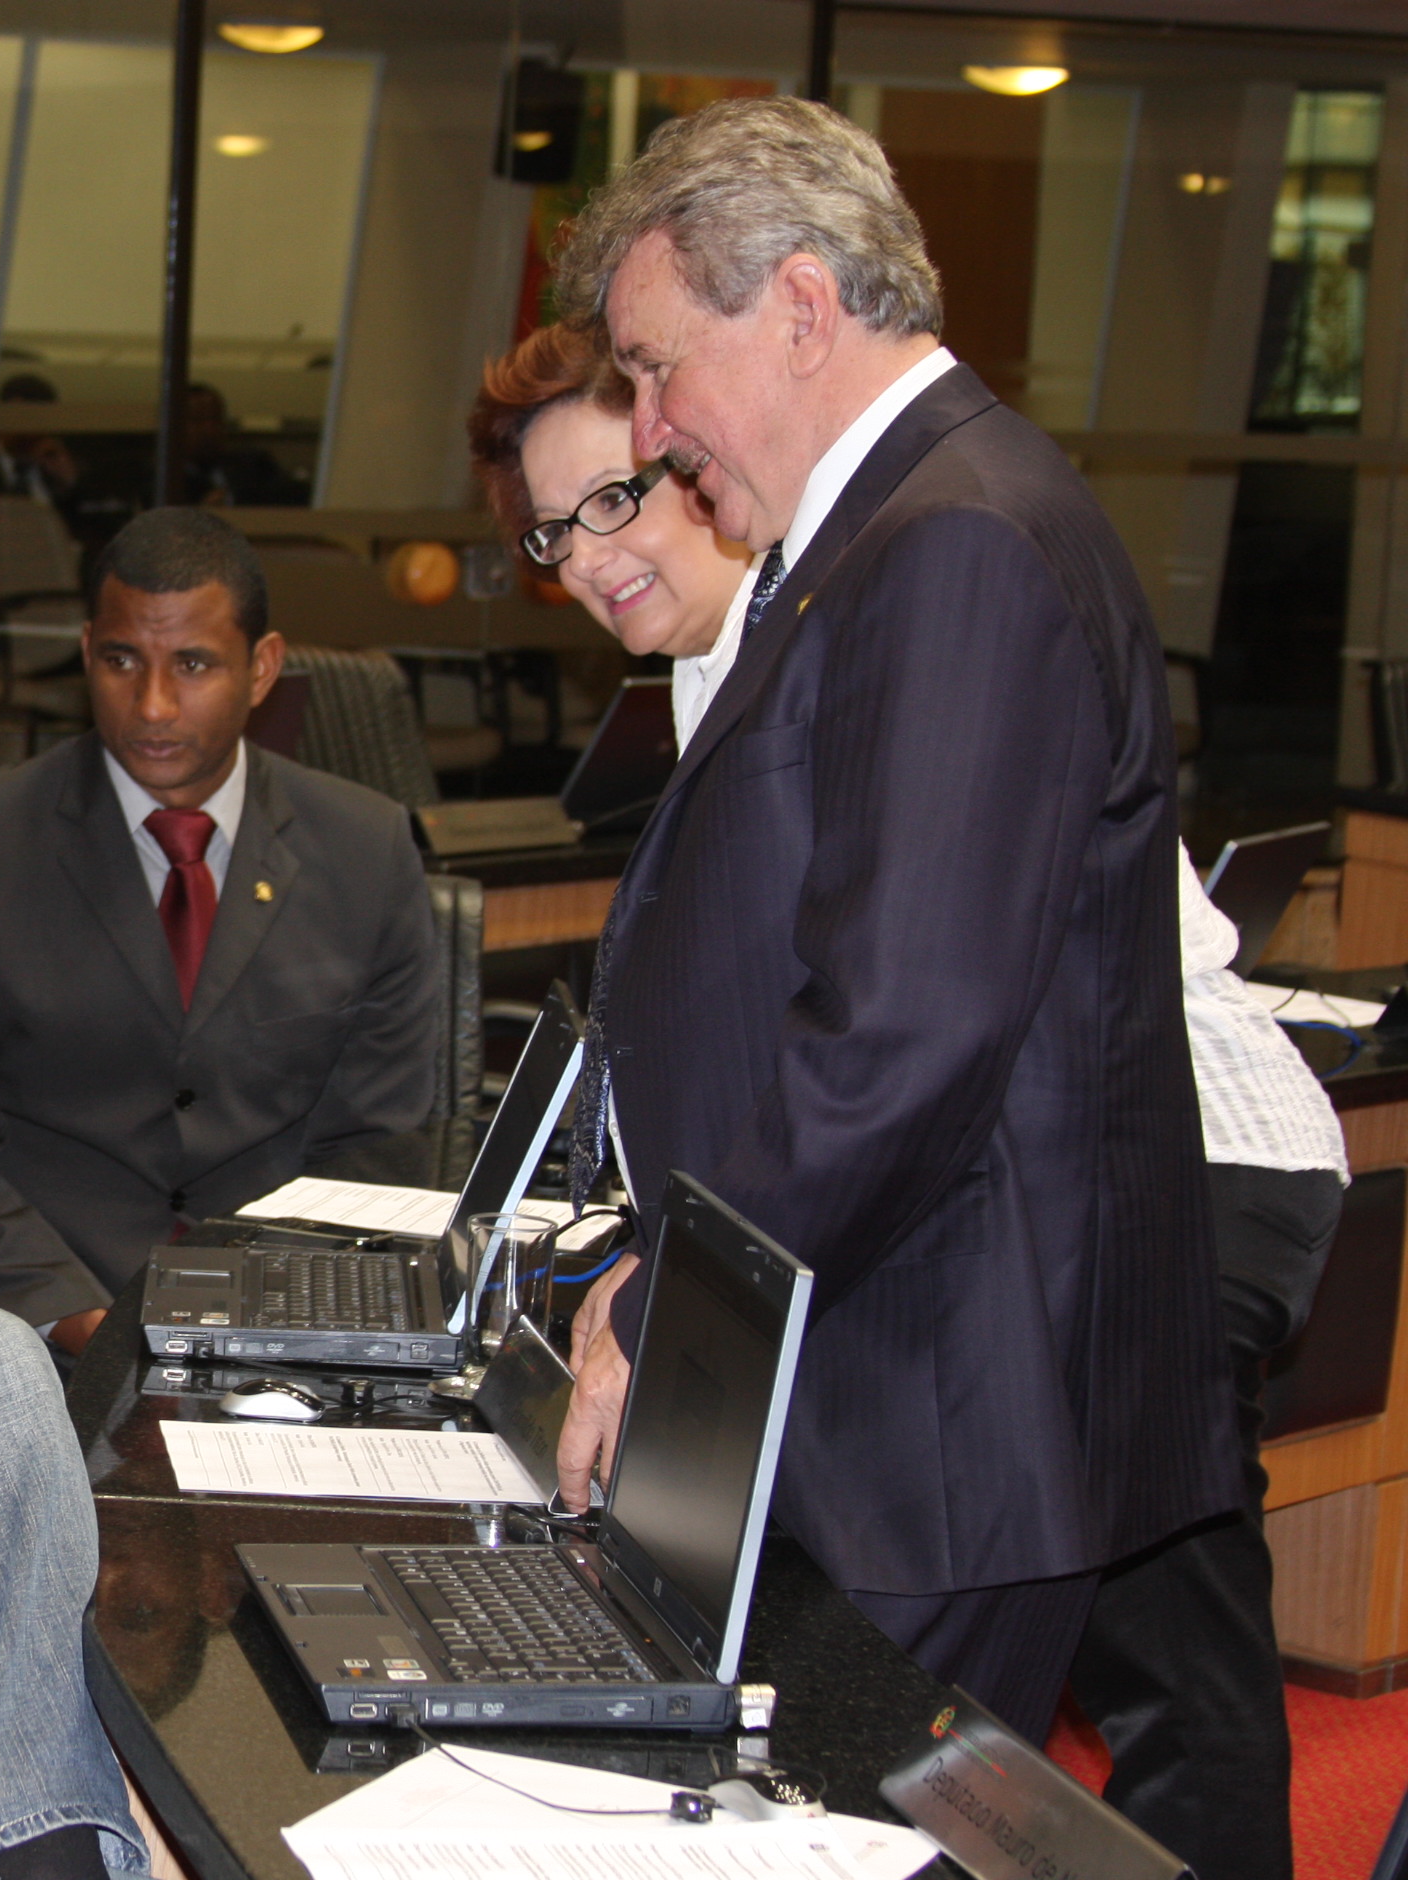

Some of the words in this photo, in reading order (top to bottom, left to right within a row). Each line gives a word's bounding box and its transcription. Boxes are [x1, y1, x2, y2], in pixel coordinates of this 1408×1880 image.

[922, 1756, 992, 1830] Deputado
[986, 1814, 1037, 1868] Mauro
[1031, 1856, 1058, 1879] de
